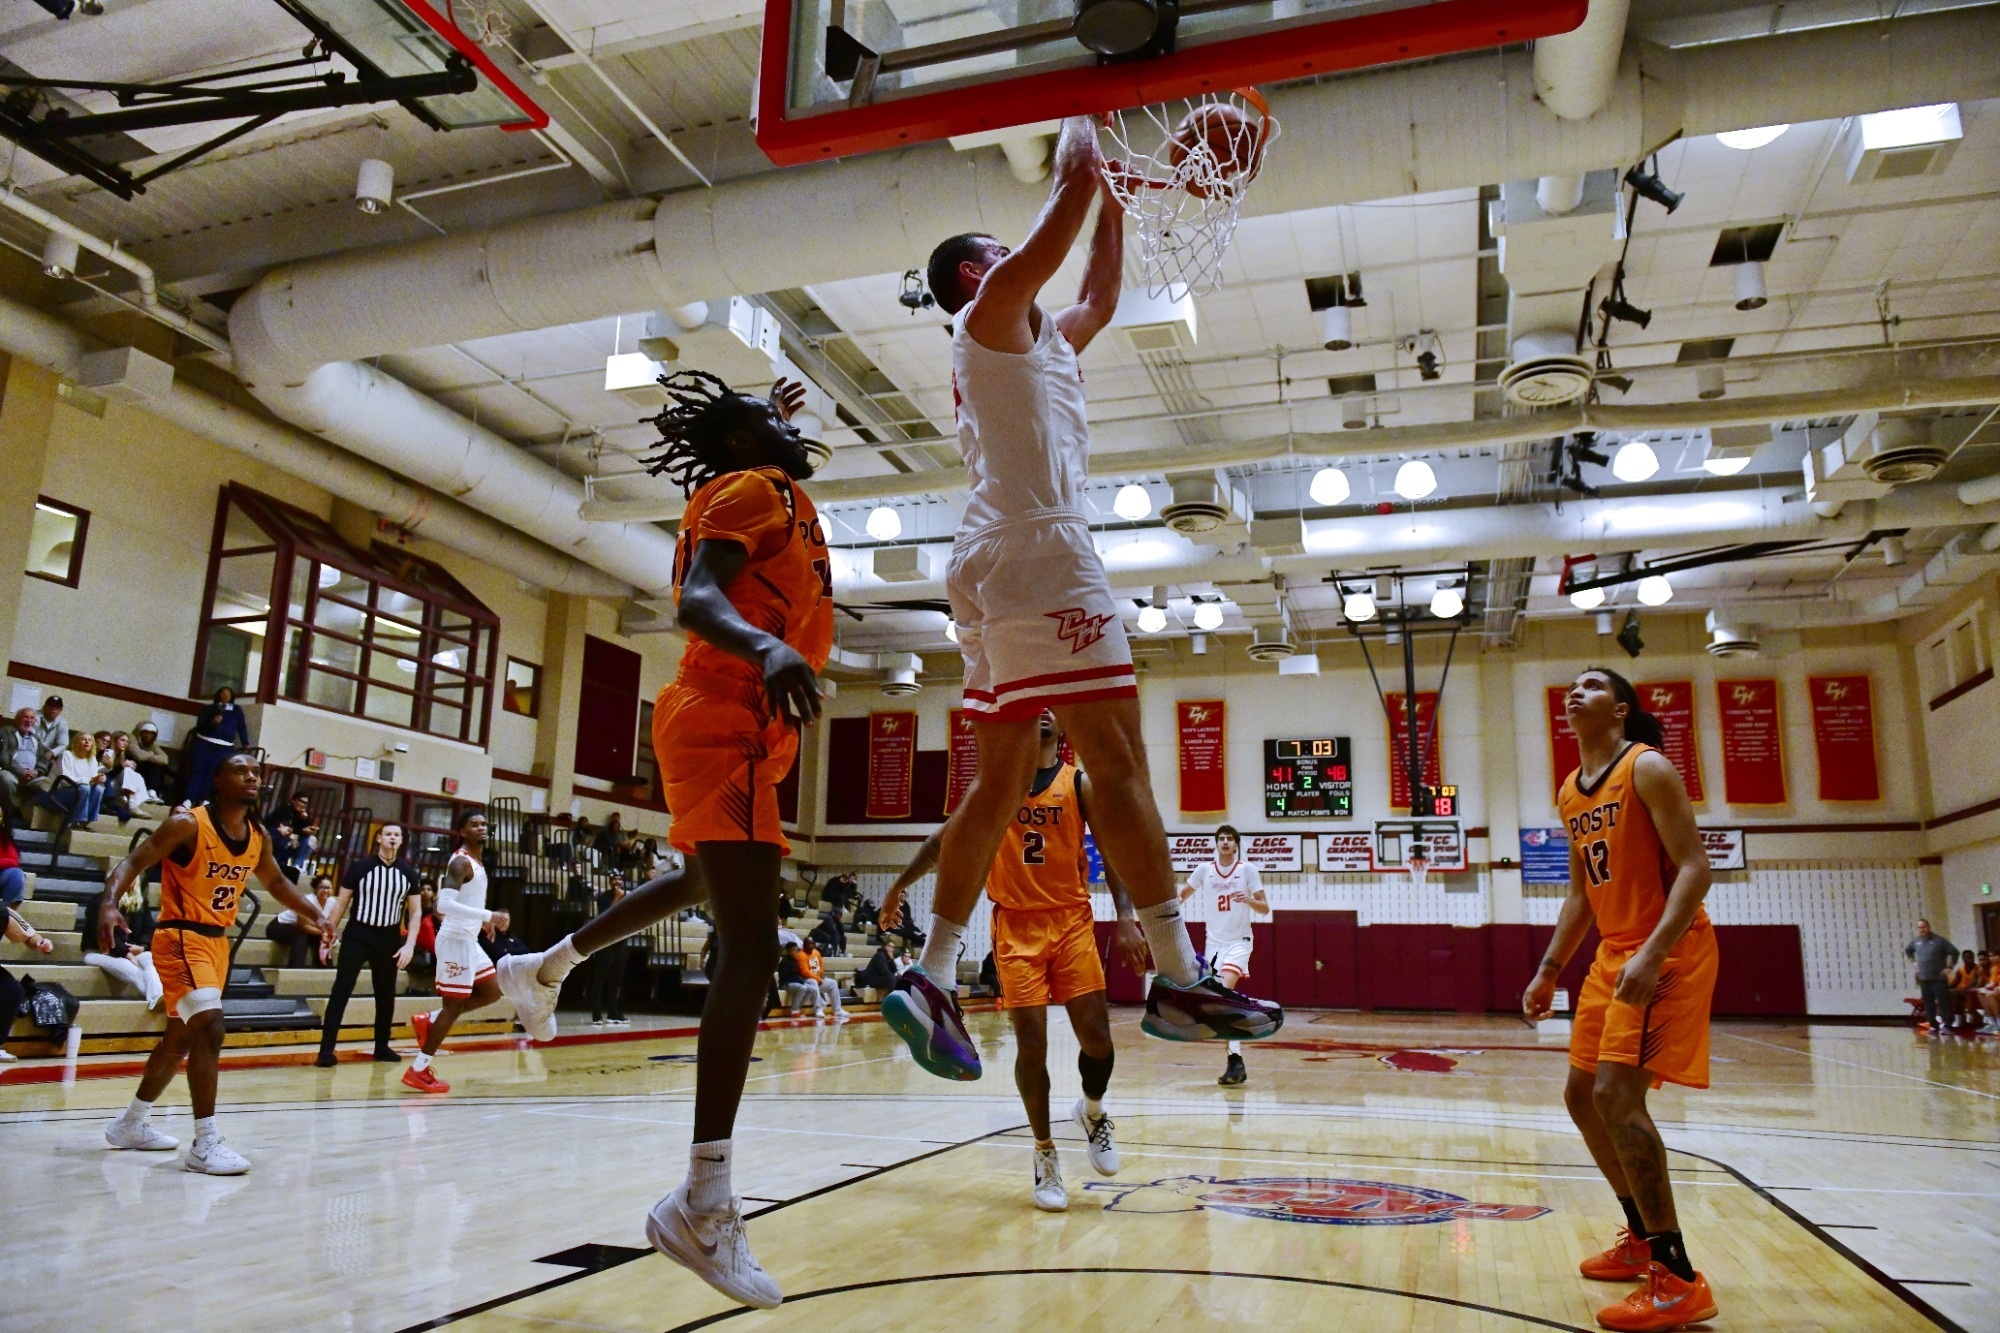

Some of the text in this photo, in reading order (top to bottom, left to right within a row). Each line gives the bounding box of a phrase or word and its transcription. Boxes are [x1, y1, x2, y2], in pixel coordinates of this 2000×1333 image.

[1651, 688, 1674, 707] CH
[1189, 706, 1209, 724] CH
[1273, 766, 1293, 782] 41
[1327, 765, 1347, 781] 48
[1266, 783, 1295, 791] HOME
[1303, 776, 1312, 789] 2
[1319, 781, 1351, 789] VISITOR
[1276, 798, 1285, 811] 4
[1340, 796, 1349, 809] 4
[1435, 797, 1452, 816] 18
[1017, 806, 1063, 826] OST
[1569, 801, 1621, 842] POST
[1023, 830, 1045, 864] 2
[1176, 838, 1210, 847] CACC
[1252, 837, 1287, 847] CACC
[1332, 837, 1369, 846] CACC
[1581, 839, 1612, 887] 12
[205, 861, 251, 882] POST
[1217, 894, 1231, 911] 21
